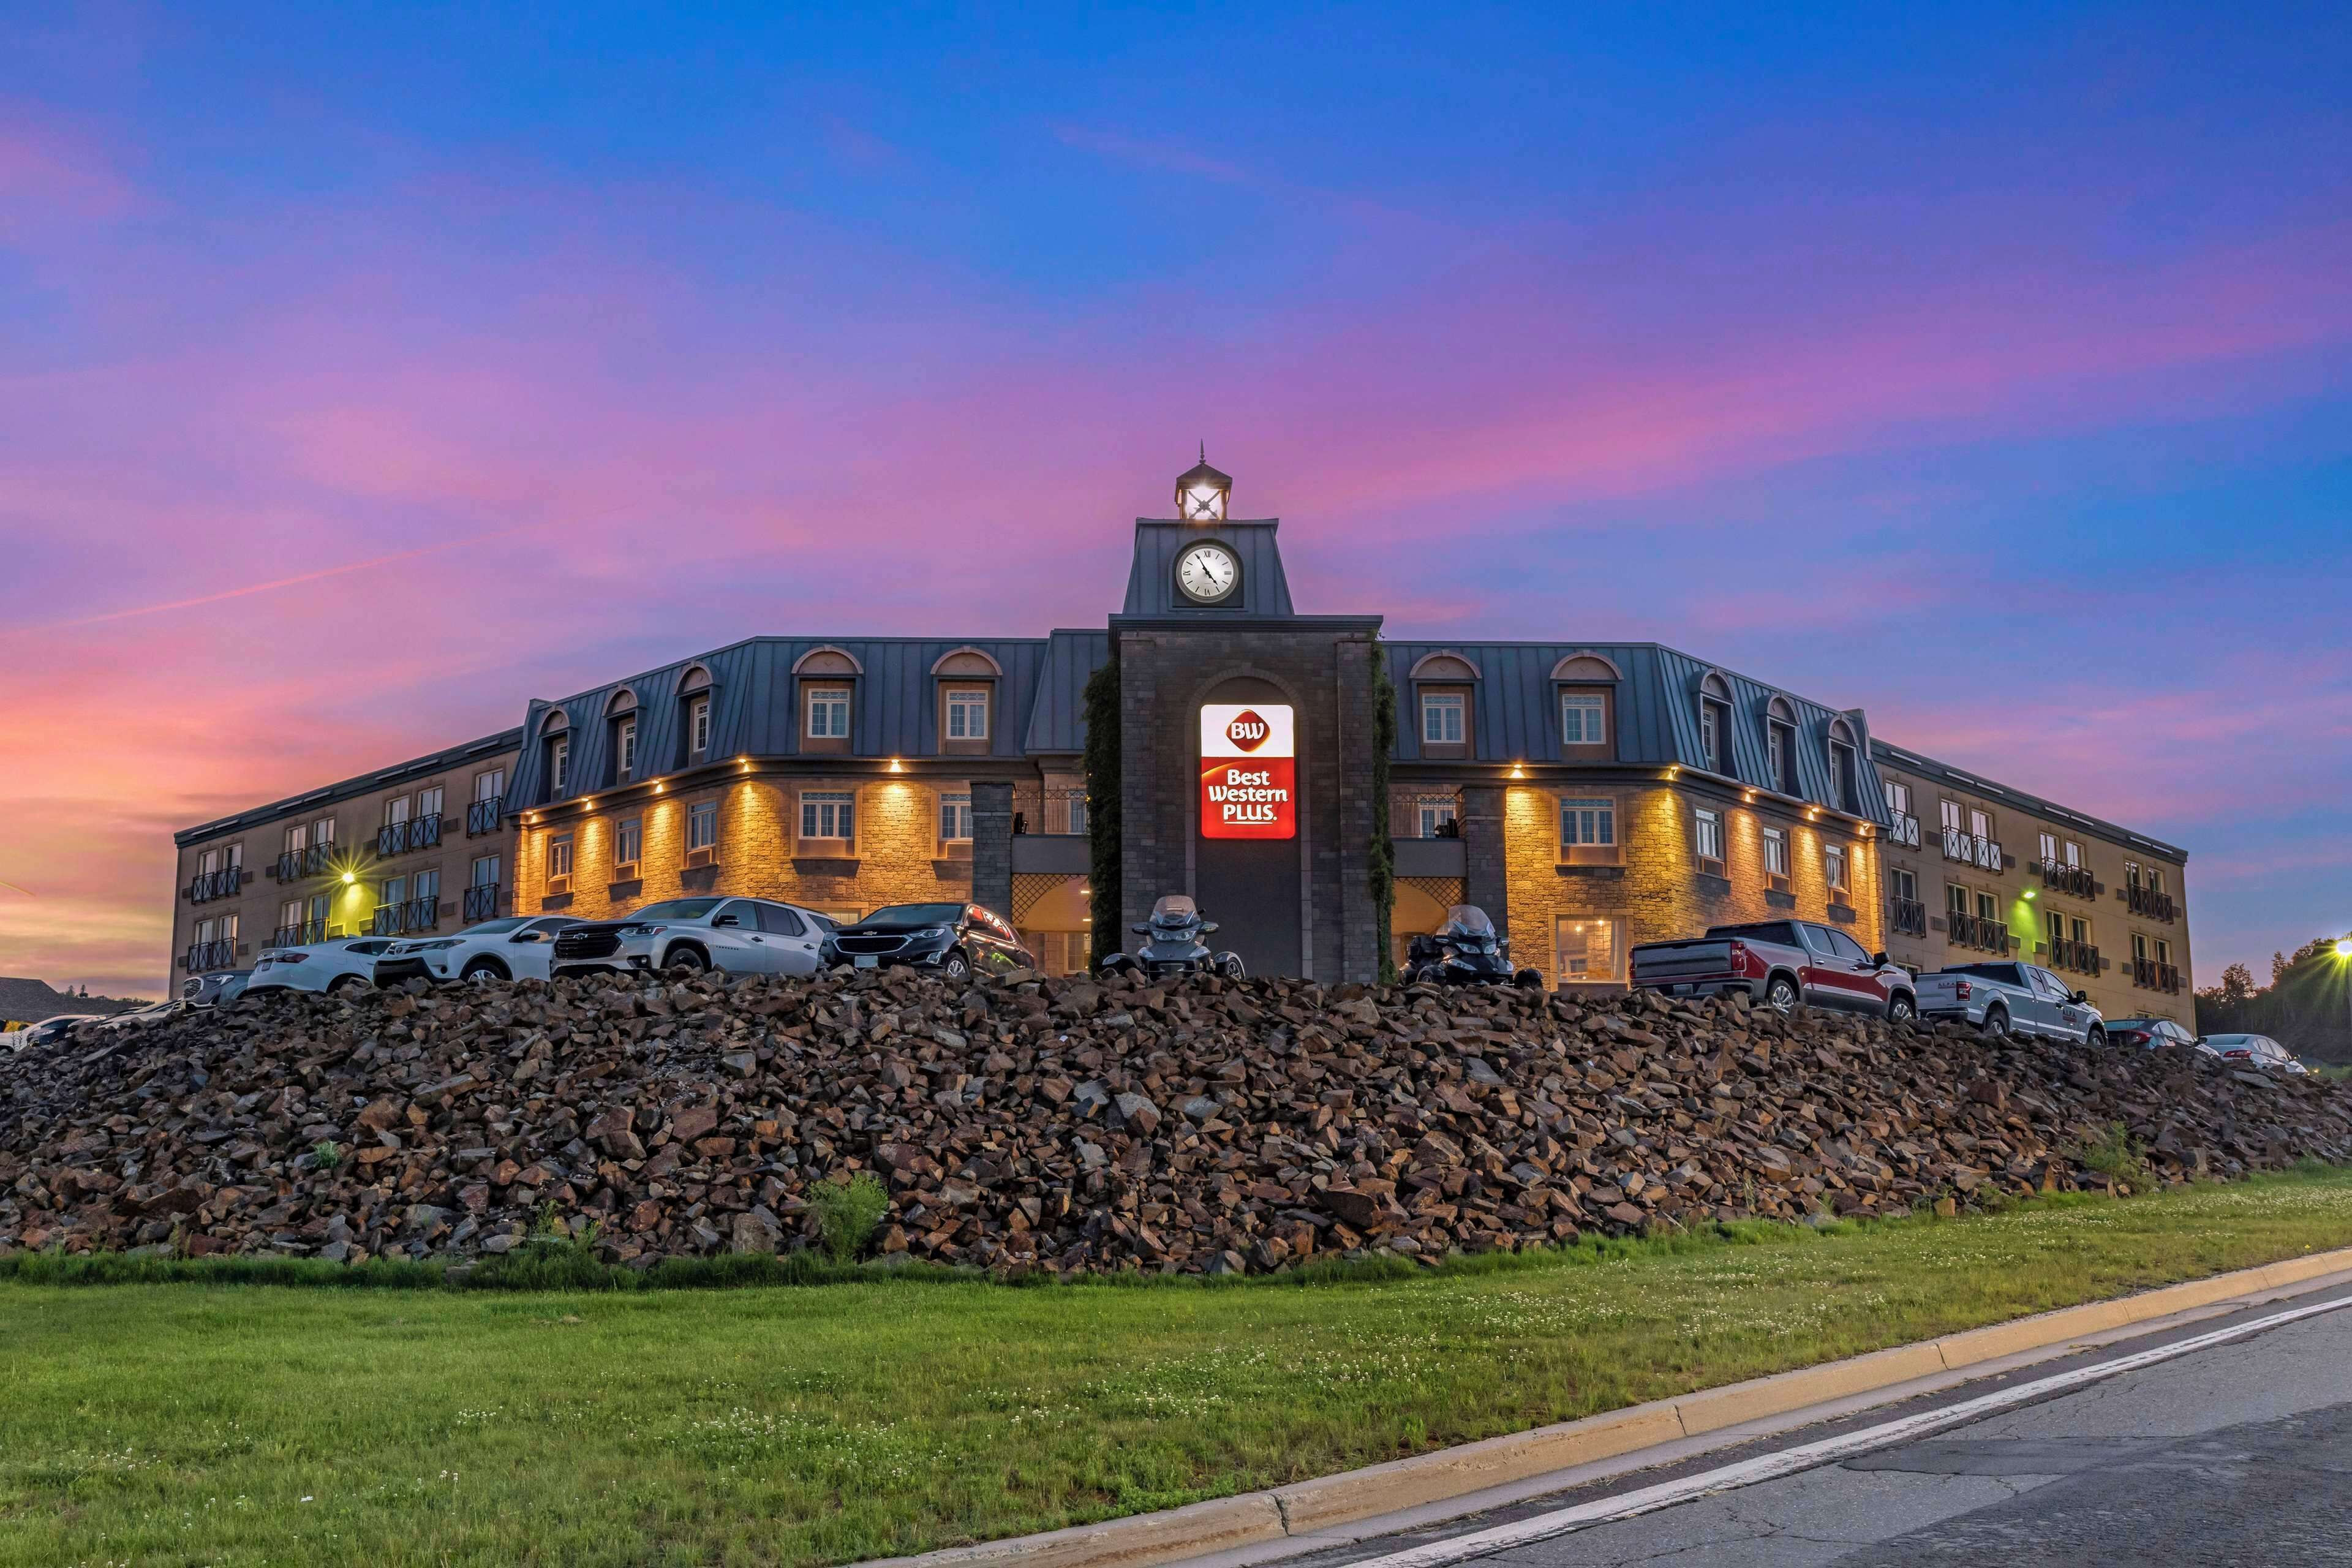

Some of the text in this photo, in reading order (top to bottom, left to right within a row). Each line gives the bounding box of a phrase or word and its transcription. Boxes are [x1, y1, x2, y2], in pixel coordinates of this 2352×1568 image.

[1231, 722, 1265, 739] BW
[1227, 769, 1270, 786] Best
[1208, 785, 1289, 802] Western
